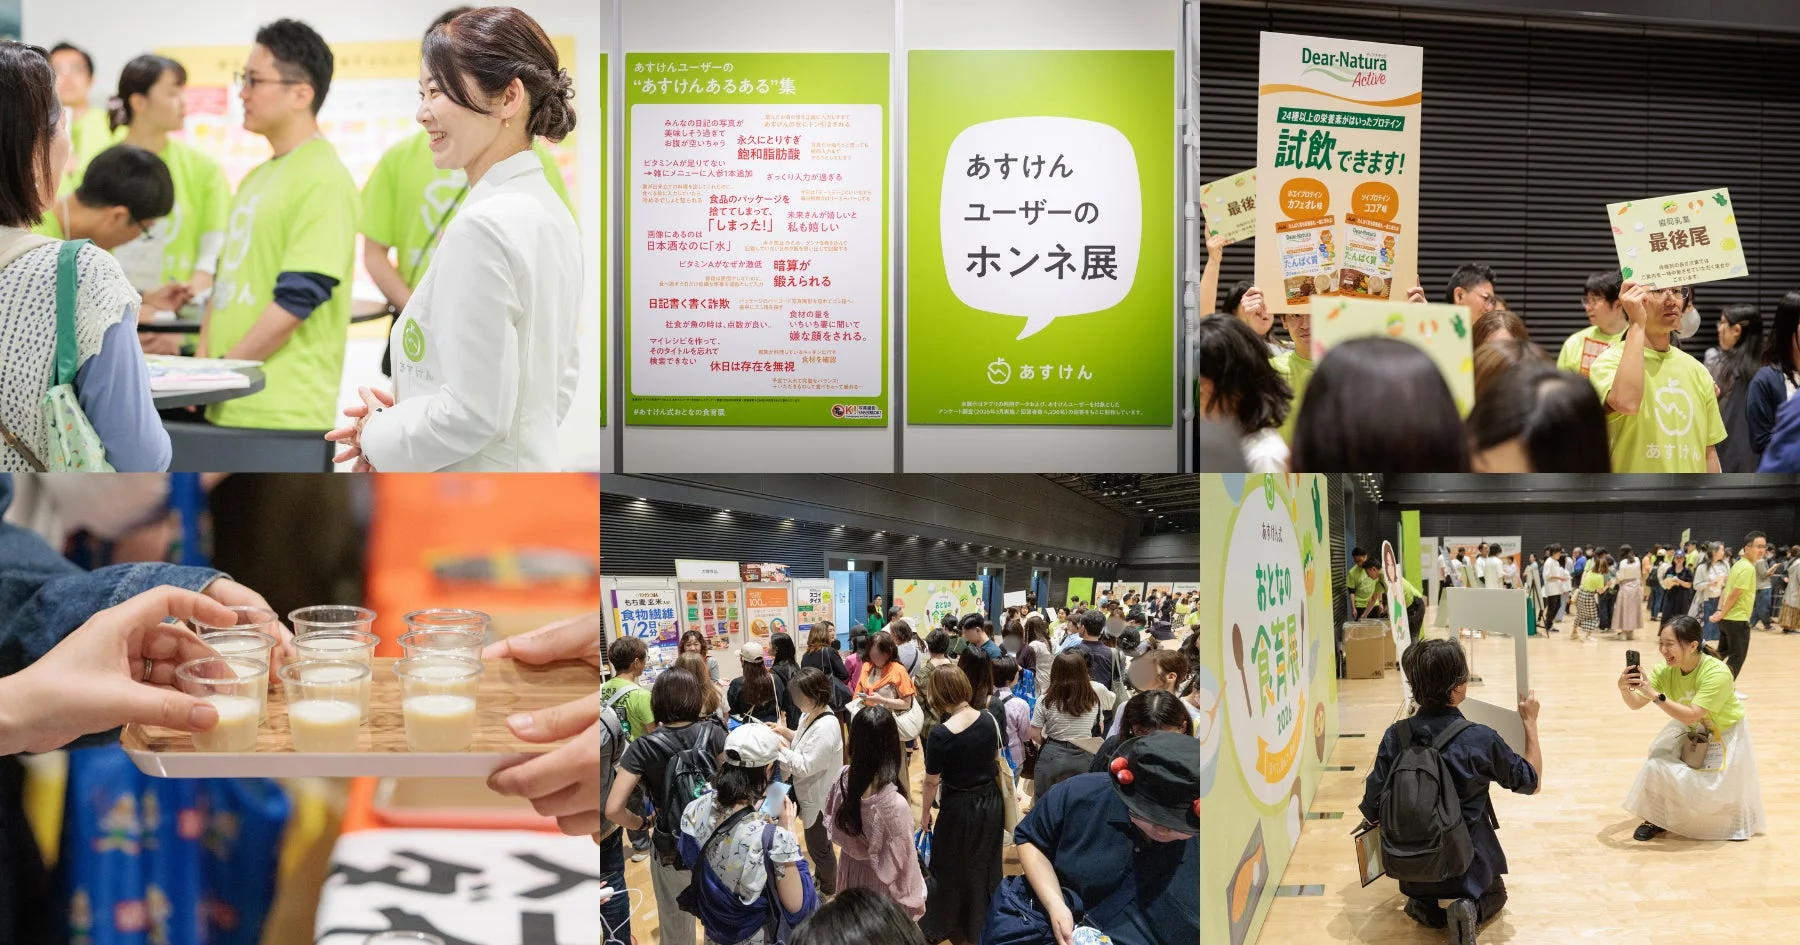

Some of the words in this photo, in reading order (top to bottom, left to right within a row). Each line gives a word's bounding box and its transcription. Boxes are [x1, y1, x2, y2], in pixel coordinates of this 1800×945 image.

[1302, 48, 1387, 71] Dear-Natura
[634, 62, 734, 73] あすけんユーザーの
[1352, 72, 1387, 88] Active
[633, 78, 796, 95] “あすけんあるある”集
[664, 119, 744, 128] みんなの日記の写真が
[1281, 111, 1402, 129] 24種以上の栄養素がはいったプロテイン
[664, 129, 725, 137] 美味しそう過ぎて
[664, 139, 726, 148] お腹が空いちゃう
[736, 134, 802, 145] 永久にとりすぎ
[737, 148, 801, 161] 飽和脂肪酸
[1275, 129, 1406, 175] 試飲できます!
[644, 159, 726, 167] ビタミンAが足りてない
[966, 153, 1074, 180] あすけん
[766, 173, 843, 181] ざっくり入力が過ぎる
[709, 194, 790, 204] 食品のパッケージを
[1227, 194, 1256, 216] 最後
[1287, 199, 1323, 210] カフェオレ味
[708, 206, 773, 217] 捨ててしまって、
[787, 211, 857, 220] 未来さんが嬉しいと
[964, 199, 1100, 225] ユーザーの
[708, 218, 773, 232] 「しまった!」
[787, 221, 840, 233] 私も嬉しい
[647, 230, 703, 239] 画像にあるのは
[1649, 226, 1711, 253] 最後尾
[647, 240, 731, 252] 日本酒なのに「水」
[679, 260, 763, 269] ビタミンAがなぜか激低
[966, 243, 1118, 281] ホンネ展
[1283, 254, 1319, 269] たんぱく質
[1344, 251, 1378, 266] たんぱく質
[773, 259, 811, 272] 暗算が
[773, 275, 831, 288] 鍛えられる
[649, 298, 730, 310] 日記書く書く詐欺
[789, 311, 830, 319] 食材の量を
[789, 320, 861, 329] いちいち妻に聞いて
[649, 337, 721, 346] マイレシピを作って、
[789, 331, 867, 342] 嫌な顔をされる。
[649, 347, 719, 355] そのタイトルを忘れて
[649, 357, 697, 366] 検索できない
[710, 361, 796, 372] 休日は存在を無視
[1019, 364, 1093, 380] あすけん
[633, 409, 725, 417] #あすけん式おとなの食育展
[1646, 442, 1701, 460] あすけん
[1262, 522, 1283, 543] あすけん式
[1255, 562, 1292, 612] おとなの
[621, 607, 675, 621] 食物繊維
[1251, 613, 1300, 719] 食育展
[1276, 702, 1294, 736] 2026
